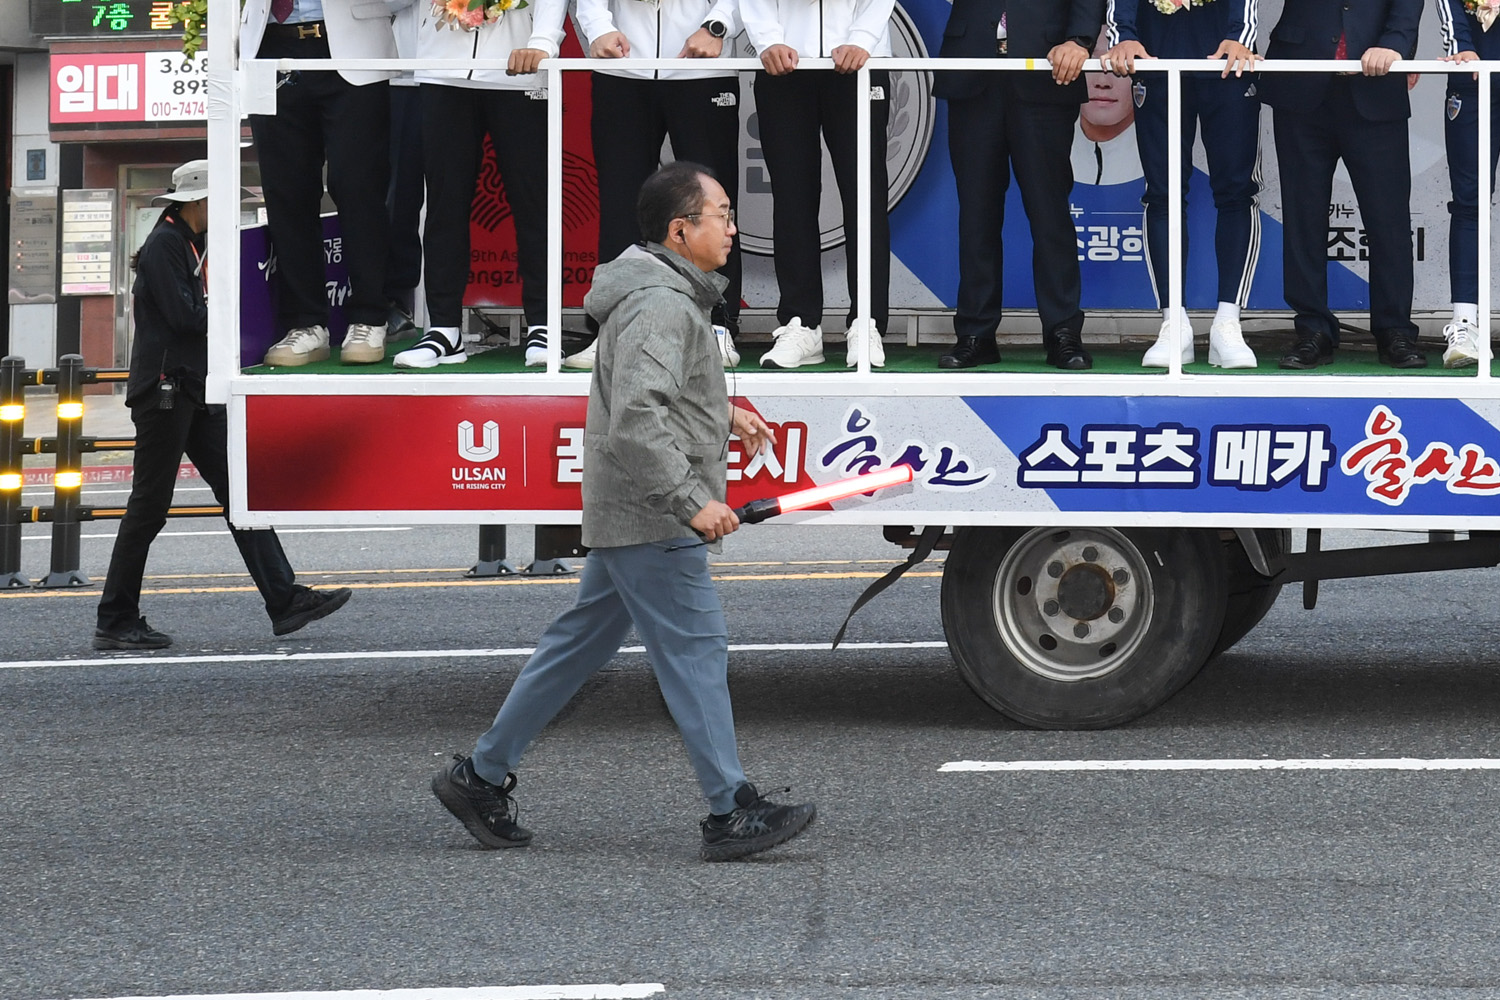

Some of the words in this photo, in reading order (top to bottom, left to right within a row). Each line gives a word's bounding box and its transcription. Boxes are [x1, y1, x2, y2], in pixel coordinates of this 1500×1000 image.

[92, 3, 134, 31] 7층
[57, 63, 139, 113] 임대
[1070, 203, 1085, 218] 누
[1329, 203, 1355, 218] 카누
[471, 249, 497, 263] 9th
[1023, 427, 1195, 484] 스포츠
[1214, 430, 1330, 485] 메카
[451, 467, 506, 481] ULSAN
